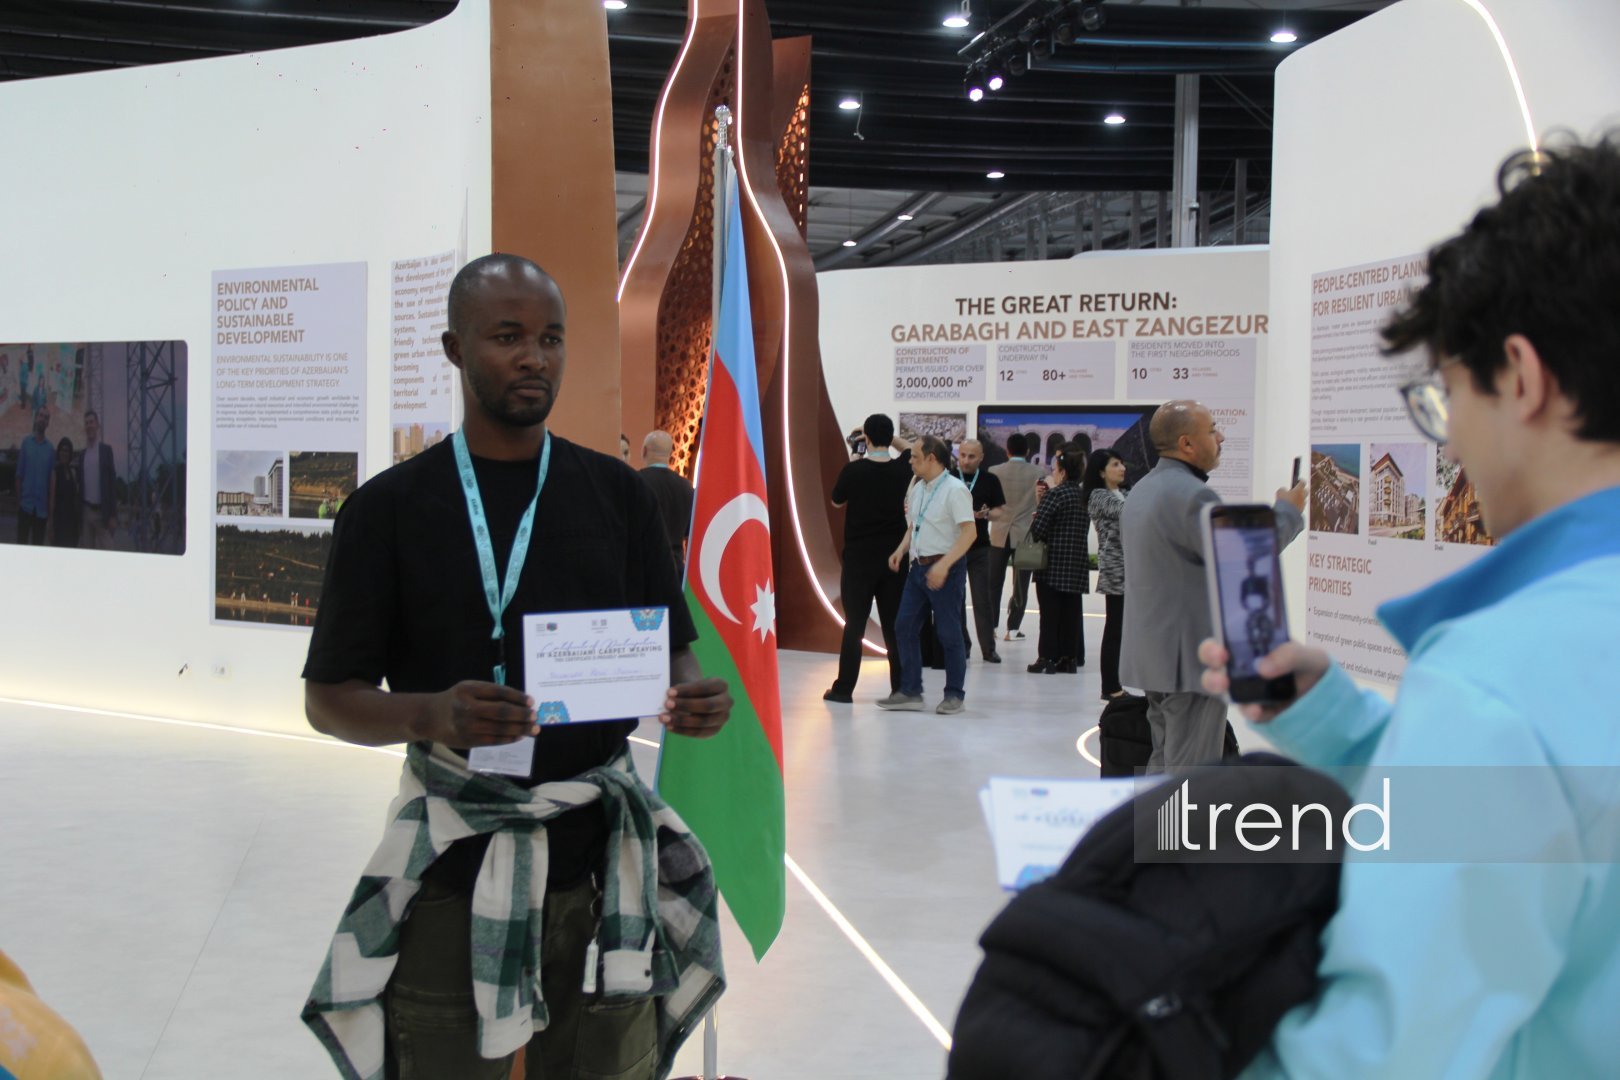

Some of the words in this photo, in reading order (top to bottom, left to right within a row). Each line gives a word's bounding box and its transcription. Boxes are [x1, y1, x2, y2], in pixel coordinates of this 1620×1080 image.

[1313, 267, 1389, 294] PEOPLE-CENTRED
[1392, 259, 1427, 280] PLANN
[217, 278, 319, 295] ENVIRONMENTAL
[217, 298, 257, 312] POLICY
[261, 296, 288, 310] AND
[955, 298, 995, 315] THE
[1001, 295, 1072, 314] GREAT
[1079, 292, 1177, 312] RETURN:
[1313, 301, 1329, 317] FOR
[1331, 293, 1375, 314] RESILIENT
[217, 313, 294, 328] SUSTAINABLE
[891, 322, 1009, 343] GARABAGH
[1017, 320, 1066, 340] AND
[1073, 318, 1129, 339] EAST
[1135, 314, 1268, 338] ZANGEZUR
[217, 329, 305, 345] DEVELOPMENT
[896, 347, 957, 356] CONSTRUCTION
[999, 344, 1056, 353] CONSTRUCTION
[1131, 342, 1172, 350] RESIDENTS
[1173, 341, 1203, 349] MOVED
[216, 354, 272, 364] ENVIRONMENTAL
[896, 356, 949, 364] SETTLEMENTS
[999, 354, 1038, 362] UNDERWAY
[1148, 350, 1167, 358] FIRST
[241, 367, 254, 376] KEY
[896, 365, 923, 373] PERMITS
[965, 364, 984, 372] OVER
[1132, 368, 1147, 380] 10
[1173, 368, 1189, 380] 33
[999, 370, 1014, 381] 12
[1042, 369, 1067, 382] 80+
[896, 377, 954, 389] 3,000,000
[1309, 553, 1325, 568] KEY
[1327, 555, 1372, 574] STRATEGIC
[1308, 576, 1352, 596] PRIORITIES
[599, 647, 625, 655] CARPET
